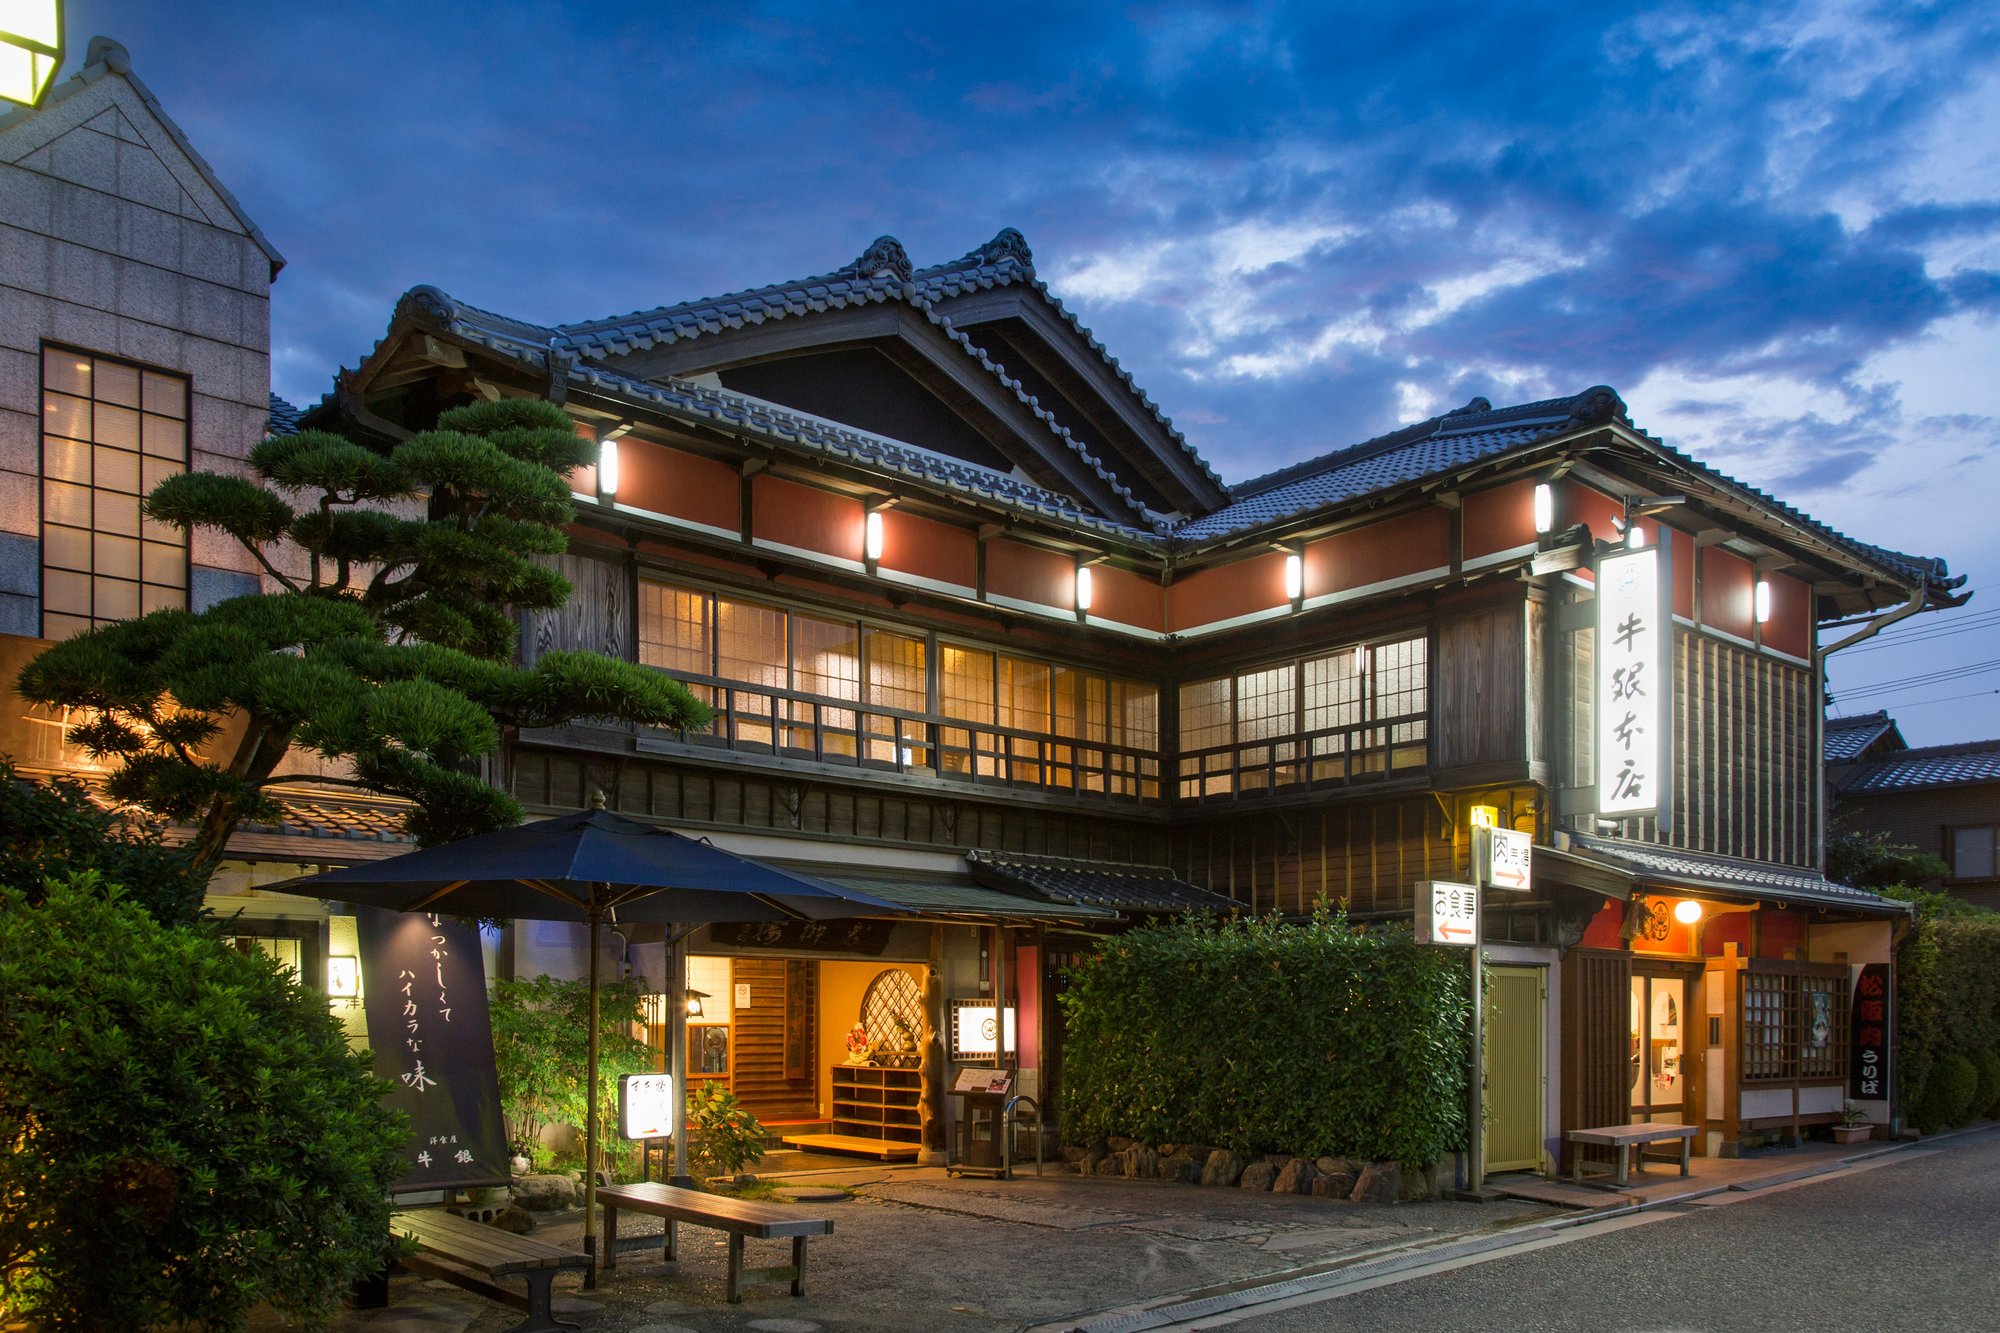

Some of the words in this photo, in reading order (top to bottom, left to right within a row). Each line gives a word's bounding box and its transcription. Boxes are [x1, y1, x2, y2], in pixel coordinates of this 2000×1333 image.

[1612, 611, 1647, 800] 牛銀本店
[1435, 888, 1475, 919] お食事
[398, 969, 437, 1092] ハイカラな味
